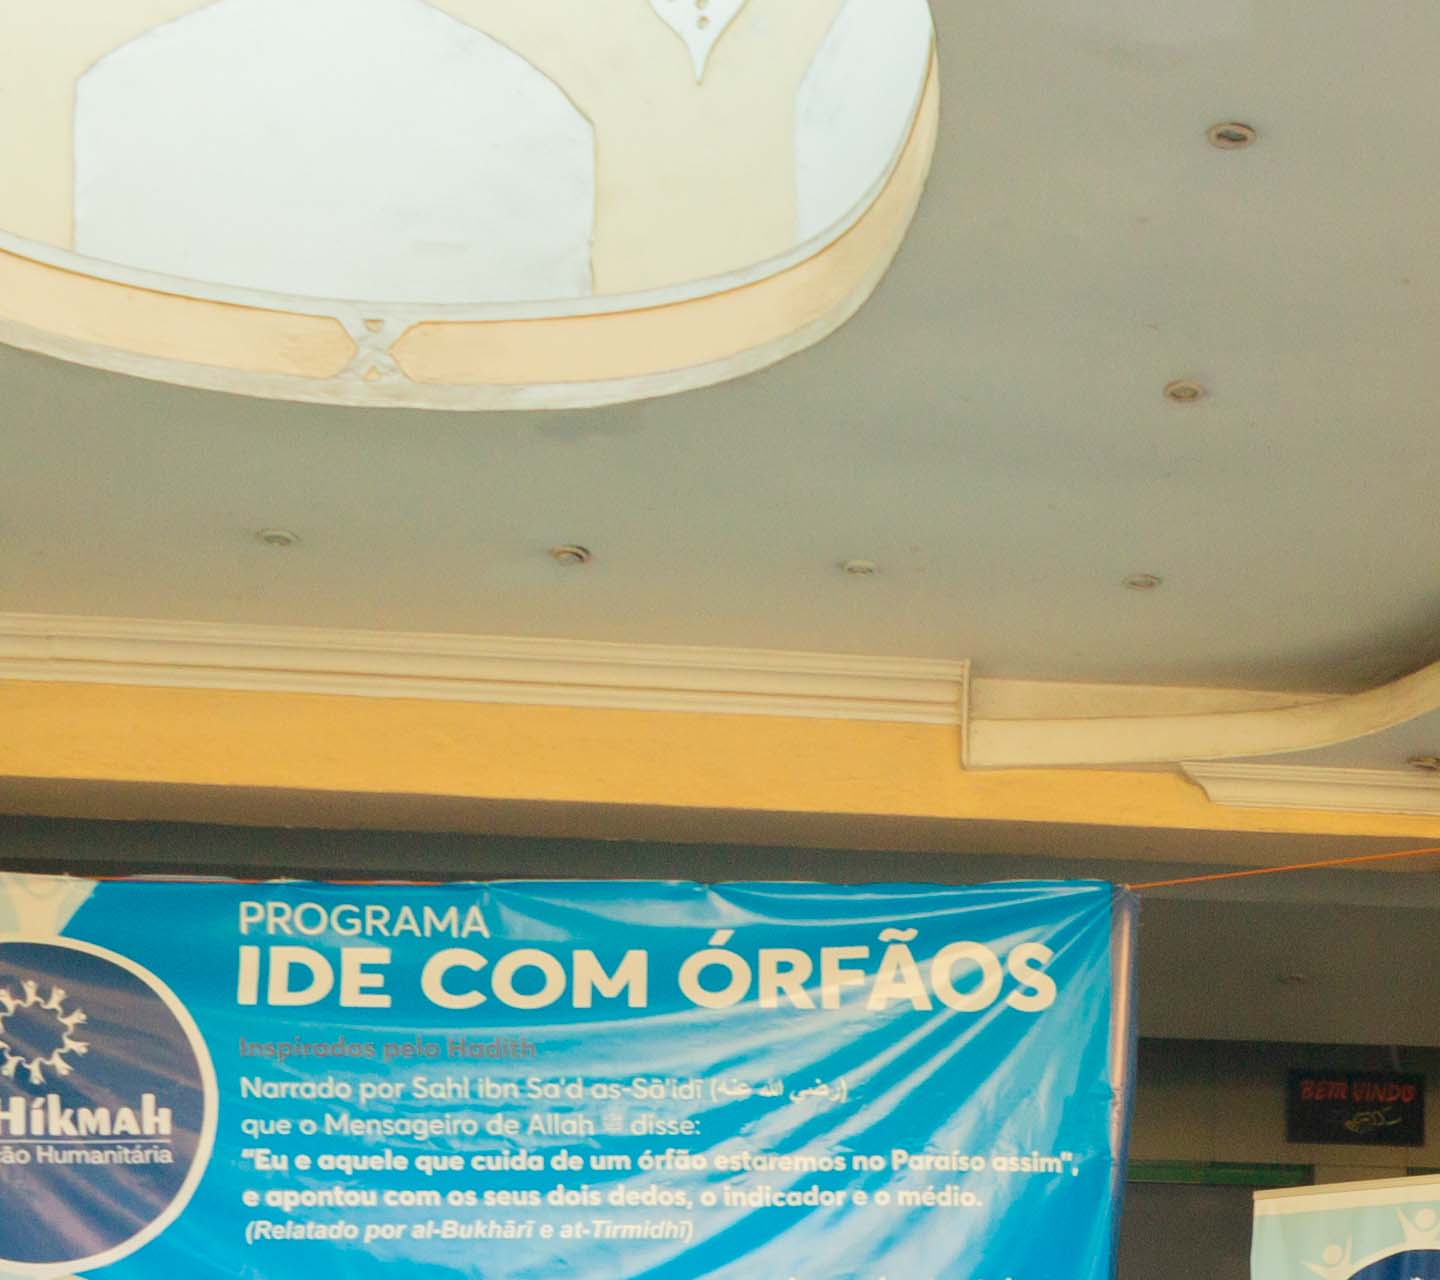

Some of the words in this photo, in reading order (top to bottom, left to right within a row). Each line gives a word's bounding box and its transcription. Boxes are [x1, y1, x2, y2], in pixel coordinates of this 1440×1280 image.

[239, 900, 491, 939] PROGRAMA
[237, 944, 392, 1008] IDE
[420, 947, 648, 1010] COM
[678, 928, 1058, 1013] ÓRFÃOS
[382, 1036, 440, 1063] pelo
[447, 1036, 537, 1059] Hadith
[240, 1076, 353, 1099] Narrado
[360, 1081, 403, 1104] por
[412, 1076, 471, 1099] Sahl
[477, 1077, 520, 1099] ibn
[241, 1117, 292, 1140] que
[298, 1117, 318, 1136] o
[324, 1112, 479, 1141] Mensageiro
[485, 1113, 520, 1136] de
[527, 1112, 595, 1136] Allah
[629, 1112, 701, 1136] disse:
[36, 1145, 174, 1165] Humanitária
[294, 1153, 312, 1172] e
[317, 1149, 409, 1176] aquele
[414, 1153, 465, 1176] que
[471, 1149, 545, 1172] cuida
[550, 1149, 584, 1172] de
[590, 1153, 632, 1172] um
[637, 1148, 708, 1172] órfão
[713, 1150, 846, 1173] estaremos
[852, 1153, 886, 1172] no
[891, 1149, 986, 1172] Paraíso
[242, 1189, 259, 1208] e
[265, 1186, 378, 1212] apontou
[383, 1189, 441, 1208] com
[447, 1189, 478, 1208] os
[484, 1189, 542, 1208] seus
[547, 1184, 603, 1208] dois
[607, 1184, 693, 1210] dedos,
[699, 1189, 717, 1208] o
[723, 1184, 847, 1208] indicador
[852, 1189, 868, 1207] e
[874, 1189, 892, 1207] o
[897, 1184, 983, 1208] médio.
[245, 1220, 359, 1245] (Relatado
[363, 1223, 407, 1244] por
[539, 1223, 554, 1240] e
